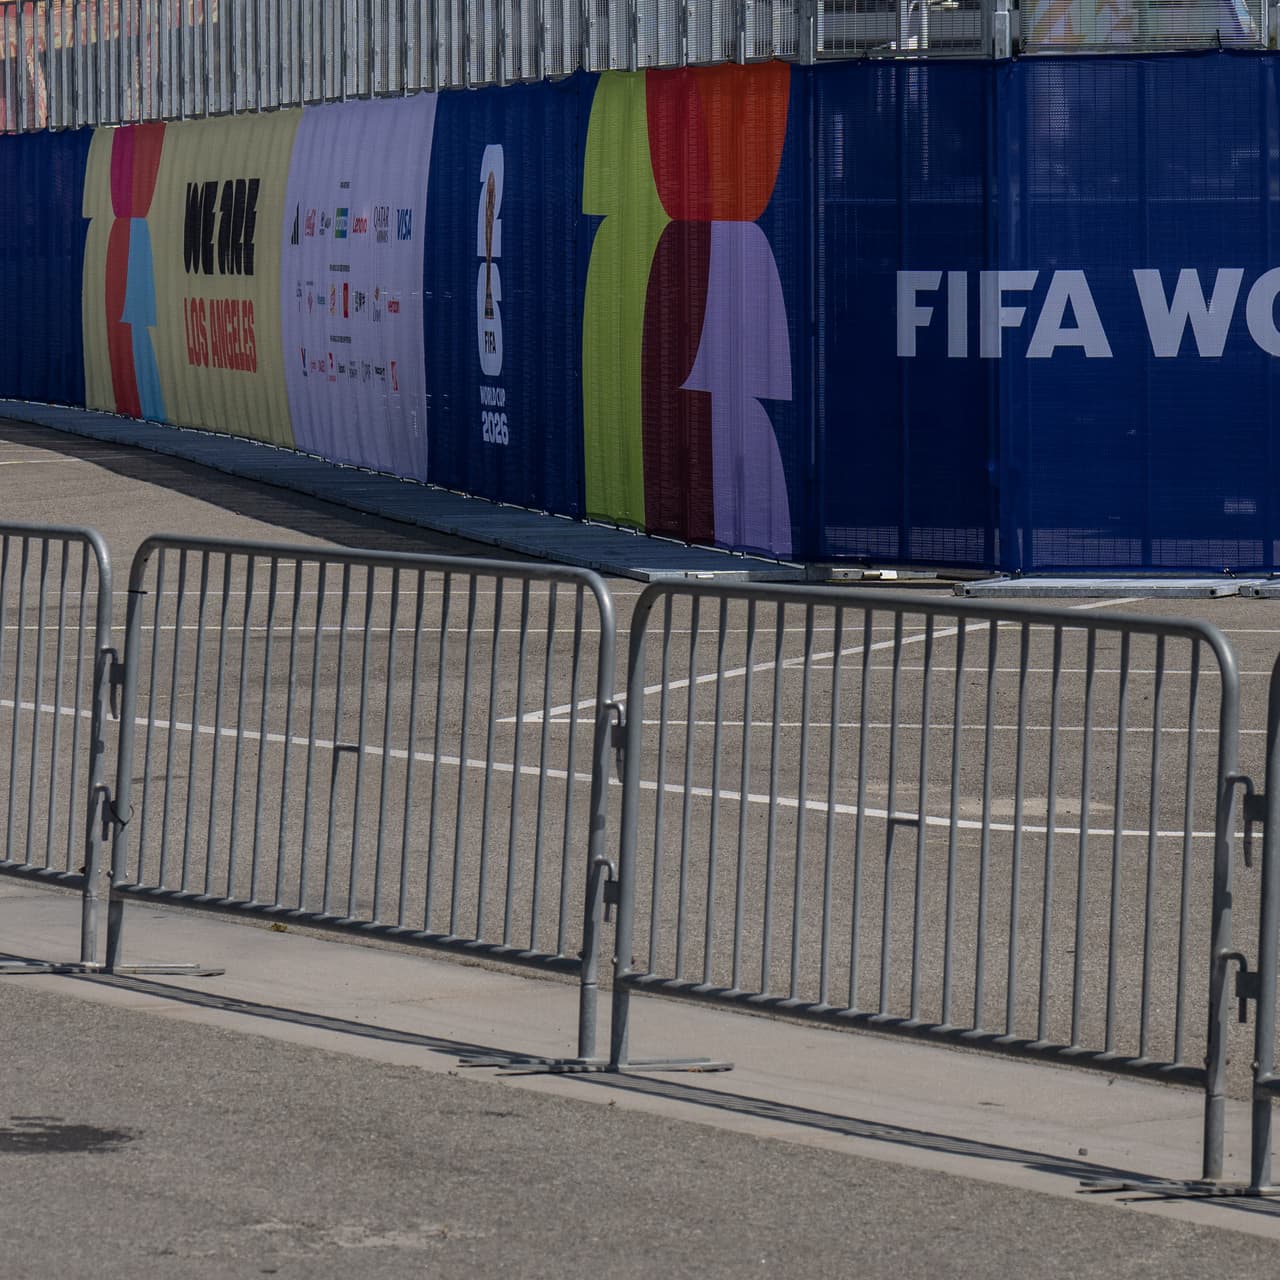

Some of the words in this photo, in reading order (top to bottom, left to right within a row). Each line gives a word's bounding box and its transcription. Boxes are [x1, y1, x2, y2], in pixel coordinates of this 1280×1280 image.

[184, 181, 218, 275] WE
[218, 178, 260, 276] ARE
[396, 208, 412, 241] VISA
[895, 269, 1113, 358] FIFA
[184, 297, 209, 368] LOS
[209, 298, 257, 373] ANGELES
[484, 330, 496, 354] FIFA
[480, 386, 495, 406] WORLD
[495, 388, 505, 407] CUP
[482, 411, 509, 445] 2026
